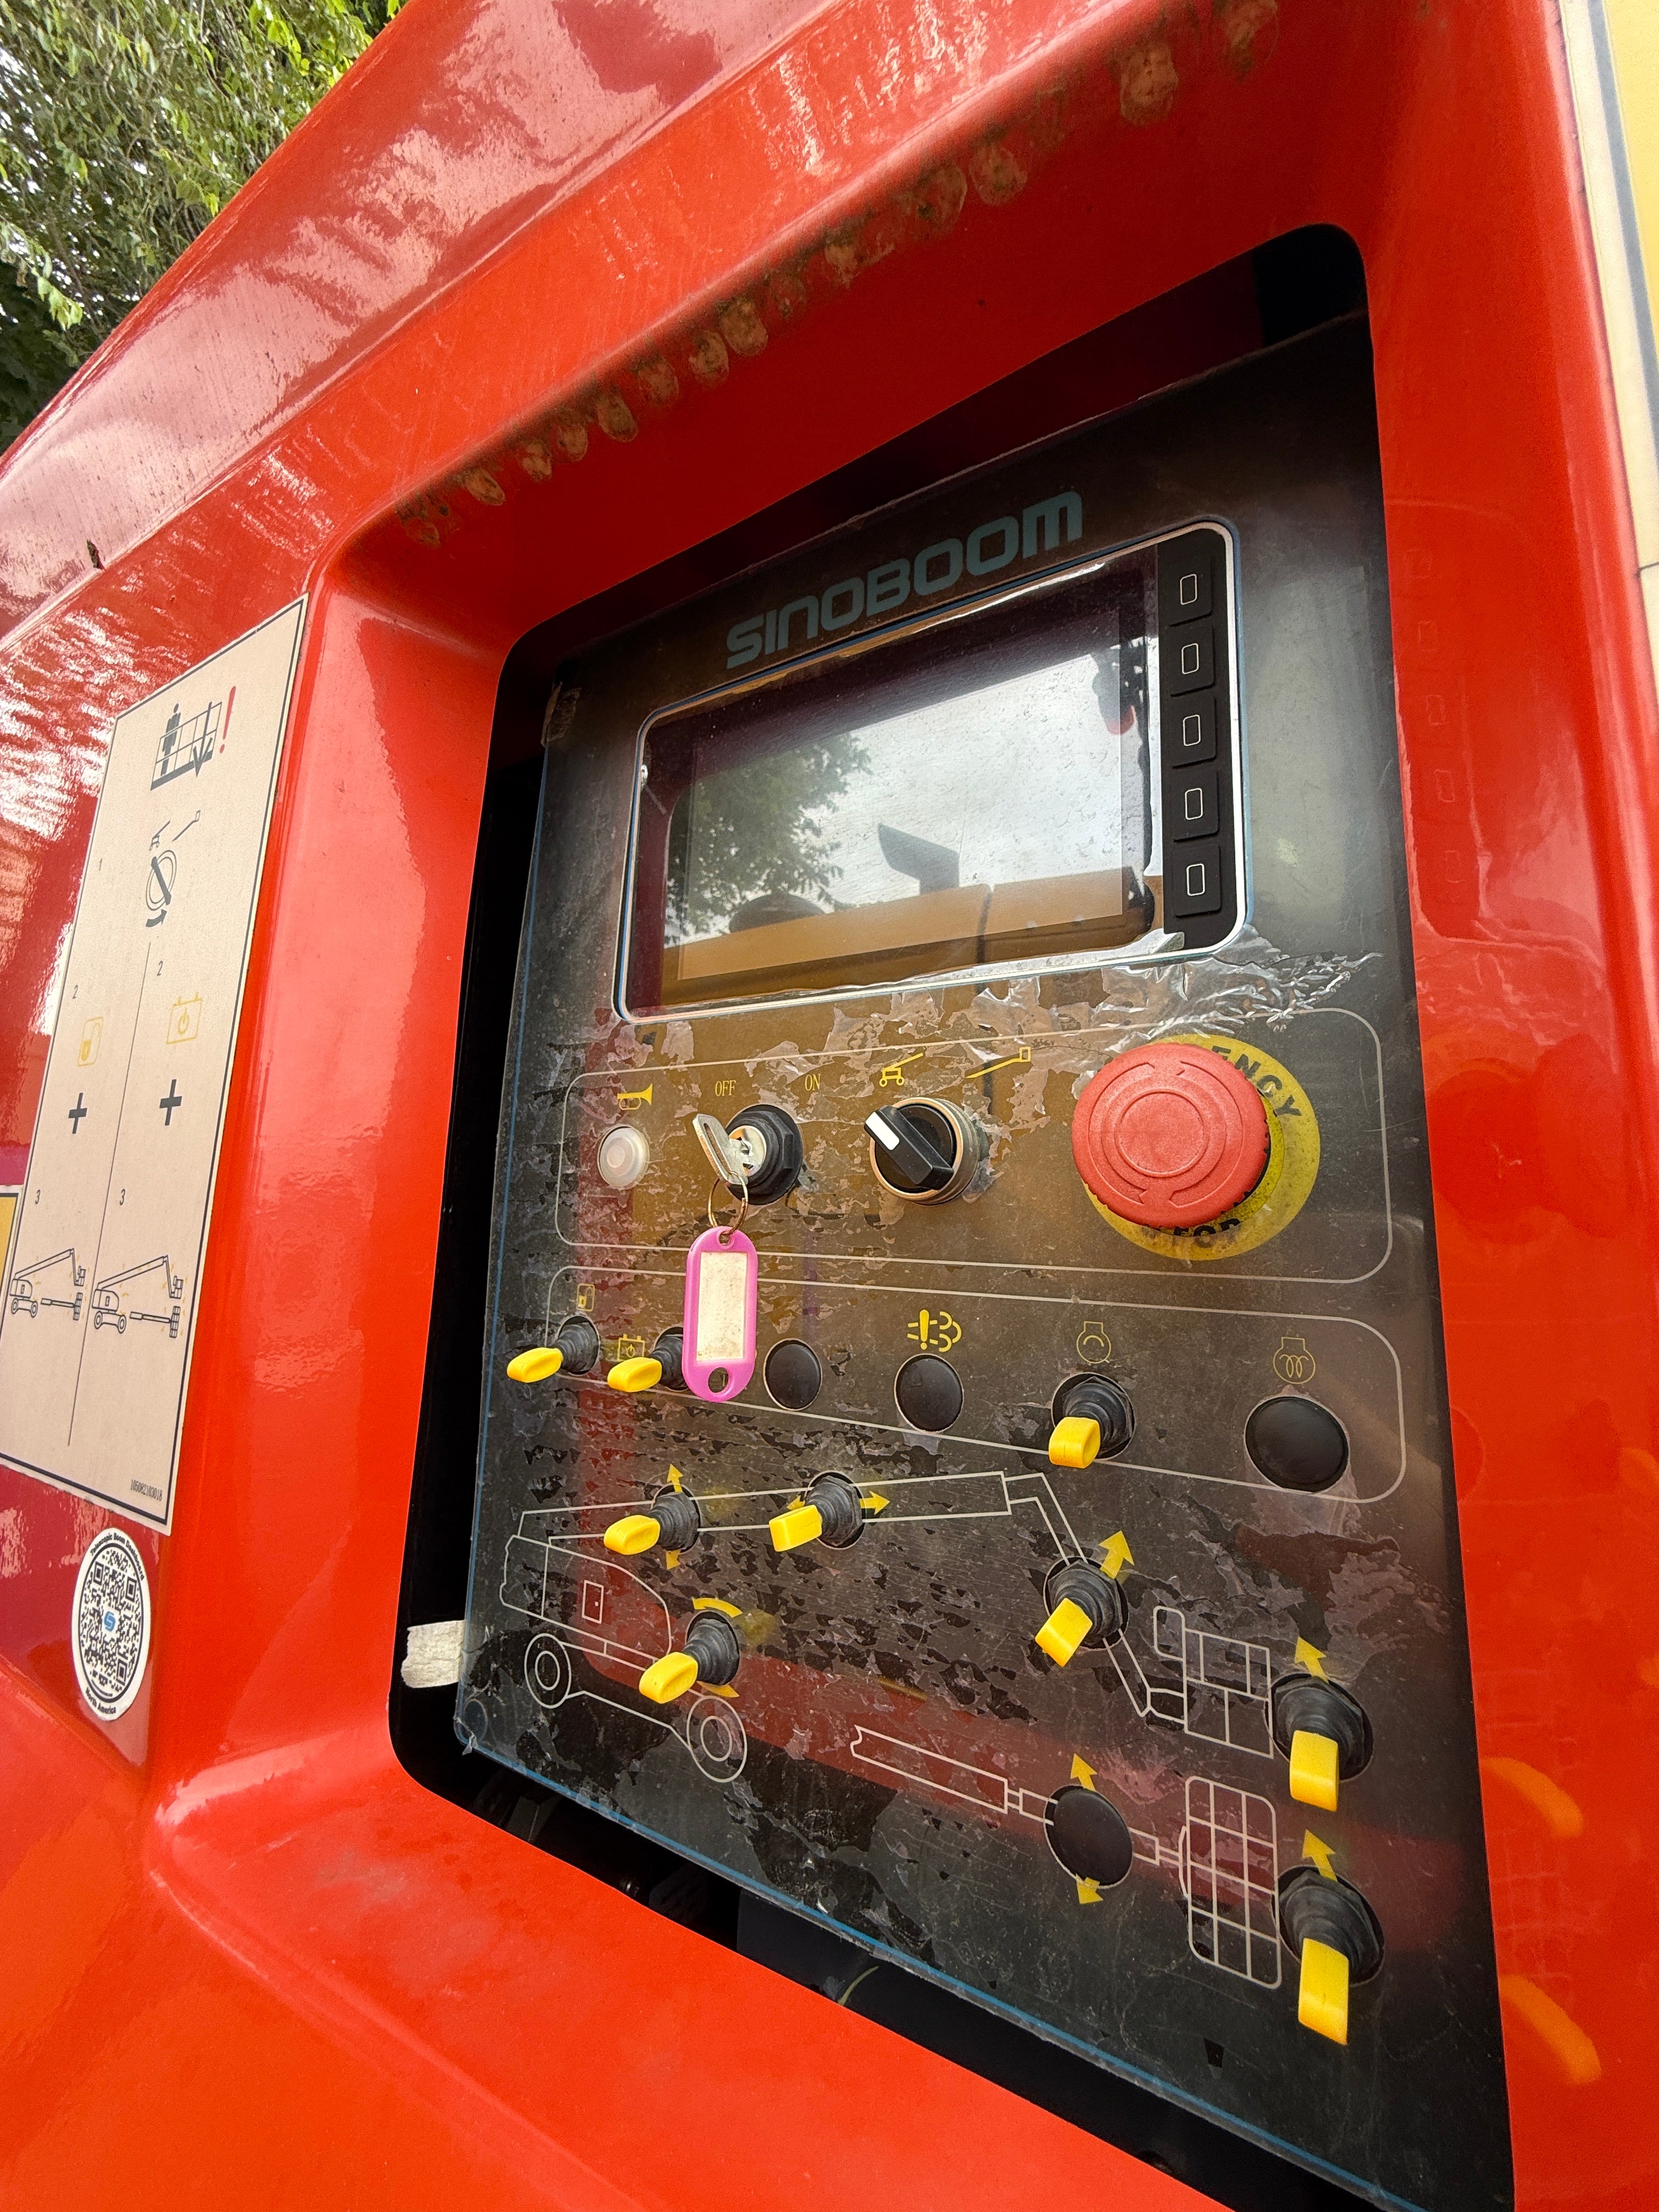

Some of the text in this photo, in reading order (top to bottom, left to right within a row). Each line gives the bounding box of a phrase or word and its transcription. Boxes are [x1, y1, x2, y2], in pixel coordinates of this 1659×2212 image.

[726, 491, 1082, 669] SINOBOOM
[156, 960, 163, 977] 2
[72, 984, 78, 1000] 2
[715, 1080, 737, 1097] OFF
[804, 1073, 821, 1091] ON
[35, 1189, 41, 1205] 3
[119, 1188, 126, 1206] 3
[114, 1532, 126, 1545] Boom
[126, 1539, 145, 1581] Dashboard
[97, 1702, 116, 1714] America
